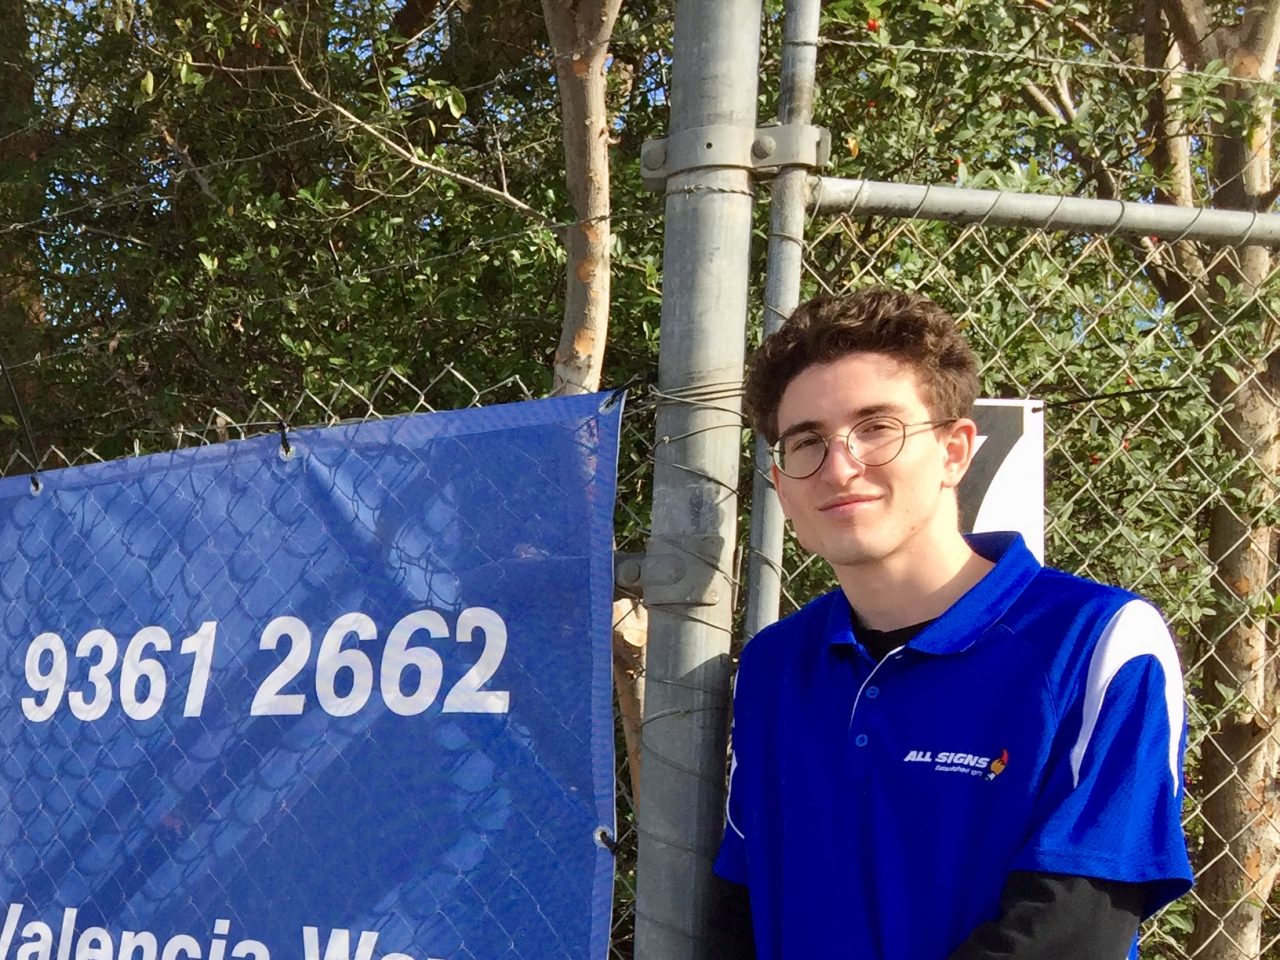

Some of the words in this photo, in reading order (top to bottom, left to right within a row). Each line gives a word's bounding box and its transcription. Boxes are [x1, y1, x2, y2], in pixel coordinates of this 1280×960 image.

[21, 621, 218, 723] 9361
[250, 607, 511, 717] 2662
[904, 750, 932, 762] ALL
[934, 752, 990, 768] SIGNS
